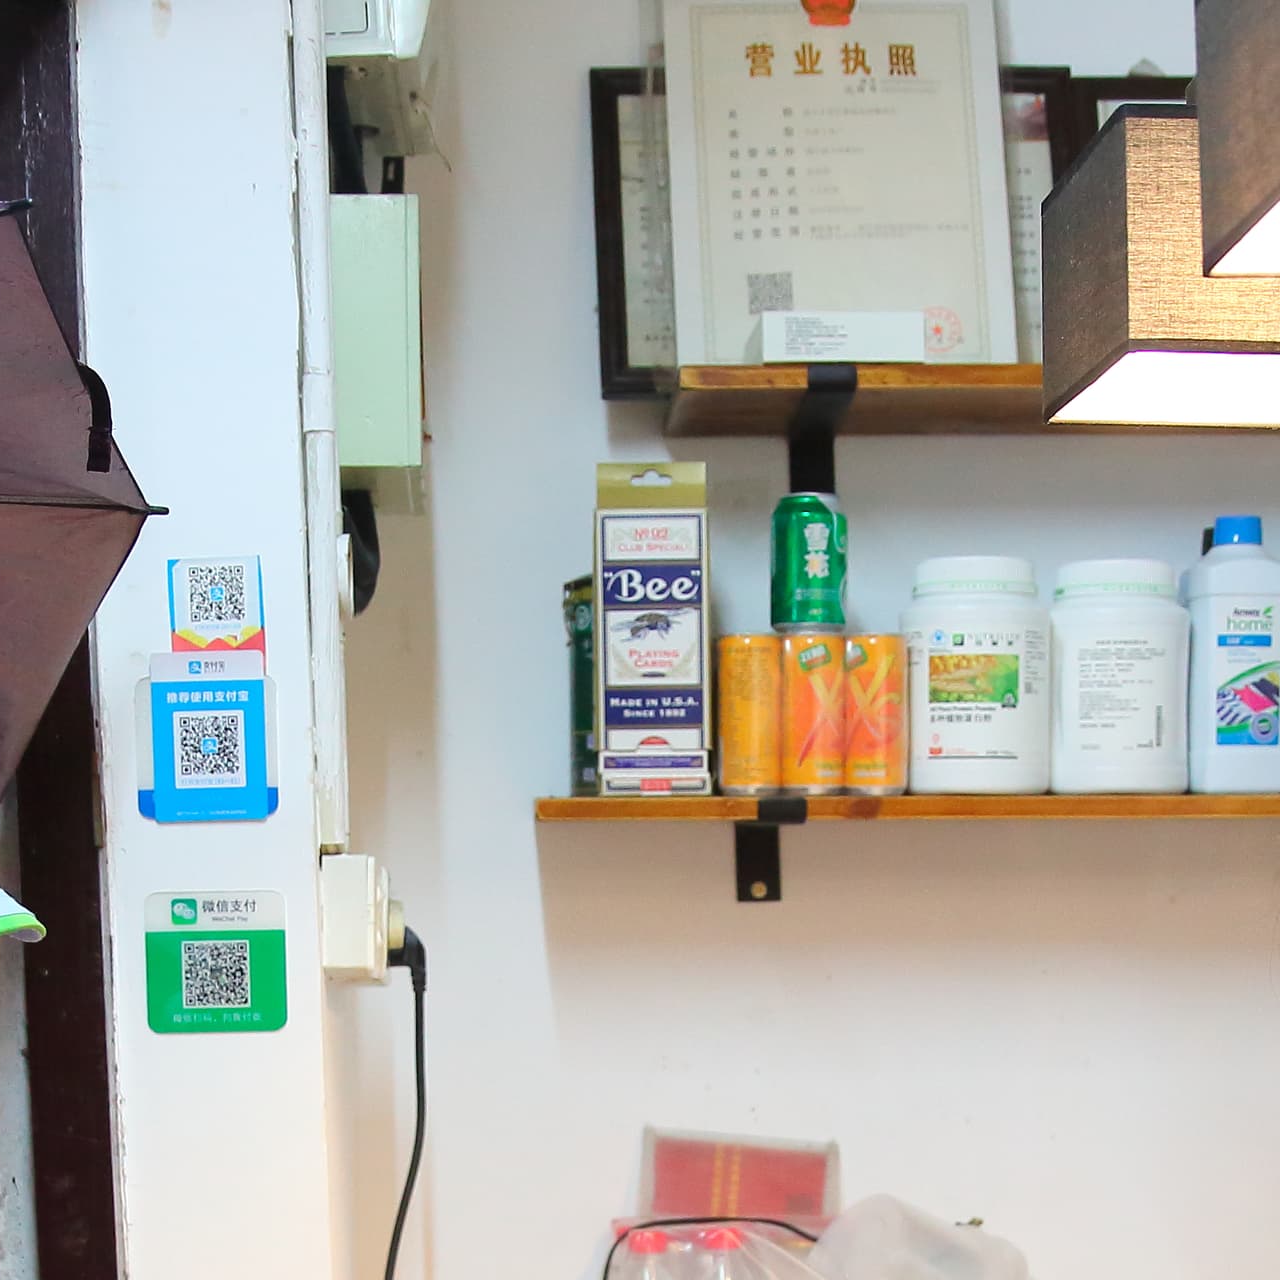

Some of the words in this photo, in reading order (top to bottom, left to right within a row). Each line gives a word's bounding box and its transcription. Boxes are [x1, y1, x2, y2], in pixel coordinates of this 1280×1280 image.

[746, 42, 917, 78] 营业执照
[1226, 616, 1272, 631] home
[166, 690, 249, 704] 推荐使用支付宝
[610, 698, 642, 707] MADE
[646, 699, 658, 707] IN
[623, 709, 656, 718] SINCE
[202, 899, 256, 913] 微信支付
